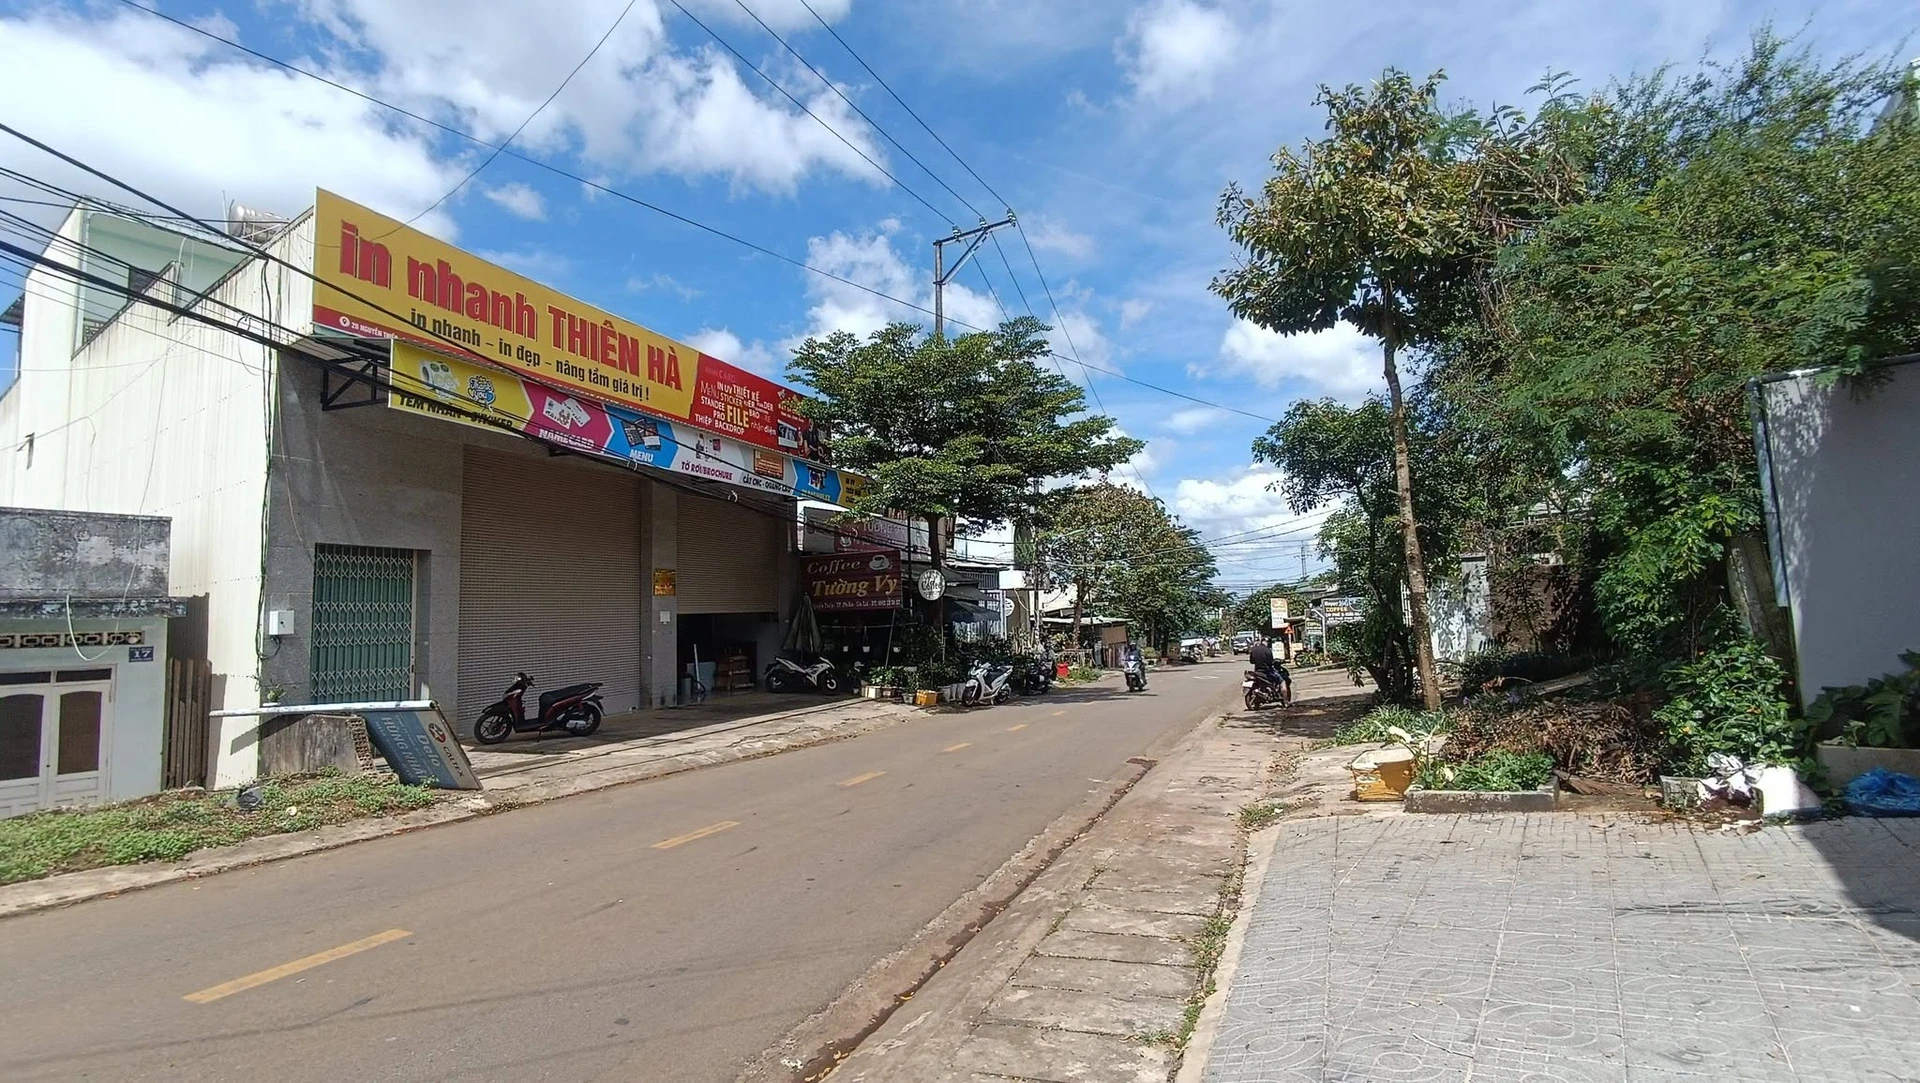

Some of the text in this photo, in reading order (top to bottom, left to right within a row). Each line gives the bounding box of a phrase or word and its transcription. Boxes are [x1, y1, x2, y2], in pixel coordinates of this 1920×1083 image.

[340, 219, 683, 392] in nhanh THIÊN HÀ
[411, 308, 427, 330] in
[432, 316, 481, 347] nhanh
[499, 338, 511, 355] in
[516, 345, 541, 367] đẹp
[556, 358, 585, 385] nâng
[612, 376, 629, 394] giá
[632, 382, 643, 401] trị
[701, 395, 725, 412] STANDEE
[720, 393, 743, 407] STICKER
[713, 410, 725, 421] PRO
[727, 405, 749, 428] FILE
[715, 419, 745, 435] BACKDROP
[629, 449, 654, 463] MENU
[807, 559, 861, 575] Coffee
[812, 574, 898, 597] Tường Vy
[134, 650, 151, 658] 17
[416, 734, 440, 766] Delo
[443, 745, 464, 778] CALTEX
